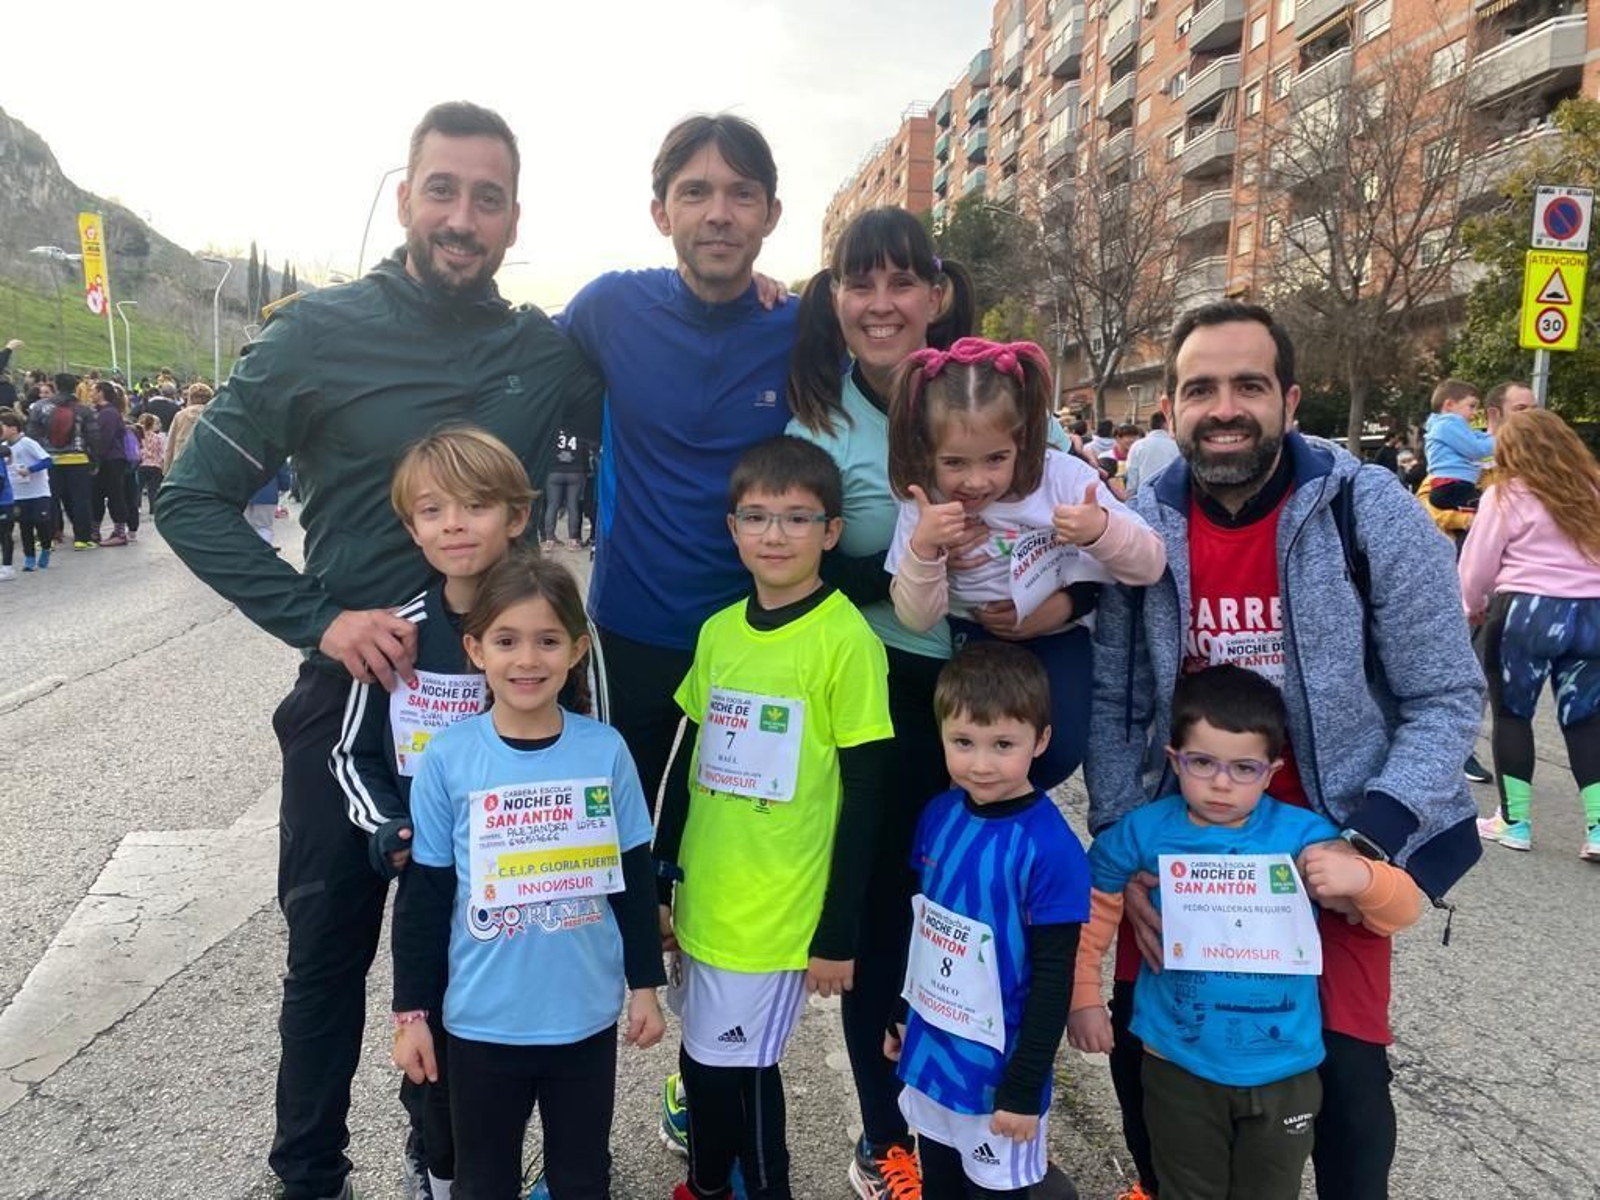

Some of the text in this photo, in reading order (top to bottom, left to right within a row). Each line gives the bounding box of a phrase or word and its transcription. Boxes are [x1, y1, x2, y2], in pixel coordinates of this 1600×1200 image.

[1531, 255, 1585, 267] ATENCIÓN
[1542, 319, 1562, 332] 30
[557, 435, 577, 450] 34
[1227, 644, 1267, 656] NOCHE
[421, 684, 480, 698] NOCHE DE
[408, 694, 429, 710] SAN
[432, 699, 480, 713] ANTÓN
[735, 705, 750, 716] DE
[725, 731, 736, 750] 7
[503, 786, 573, 799] CARRERA ESCOLAR
[503, 793, 572, 811] NOCHE DE
[486, 813, 518, 829] SAN
[521, 805, 573, 825] ANTÓN
[499, 856, 619, 878] C.E.I.P. GLORIA FUERTES
[1190, 869, 1255, 880] NOCHE DE
[518, 875, 593, 896] INNOVASUR
[1174, 881, 1203, 894] SAN
[1206, 880, 1256, 894] ANTÓN
[1183, 904, 1291, 913] PEDRO VALDERAS REGUERO
[1235, 919, 1242, 928] 4
[953, 928, 969, 942] DE
[1203, 946, 1281, 961] INNOVASUR
[940, 956, 953, 977] 8
[973, 1152, 1000, 1165] adidas
